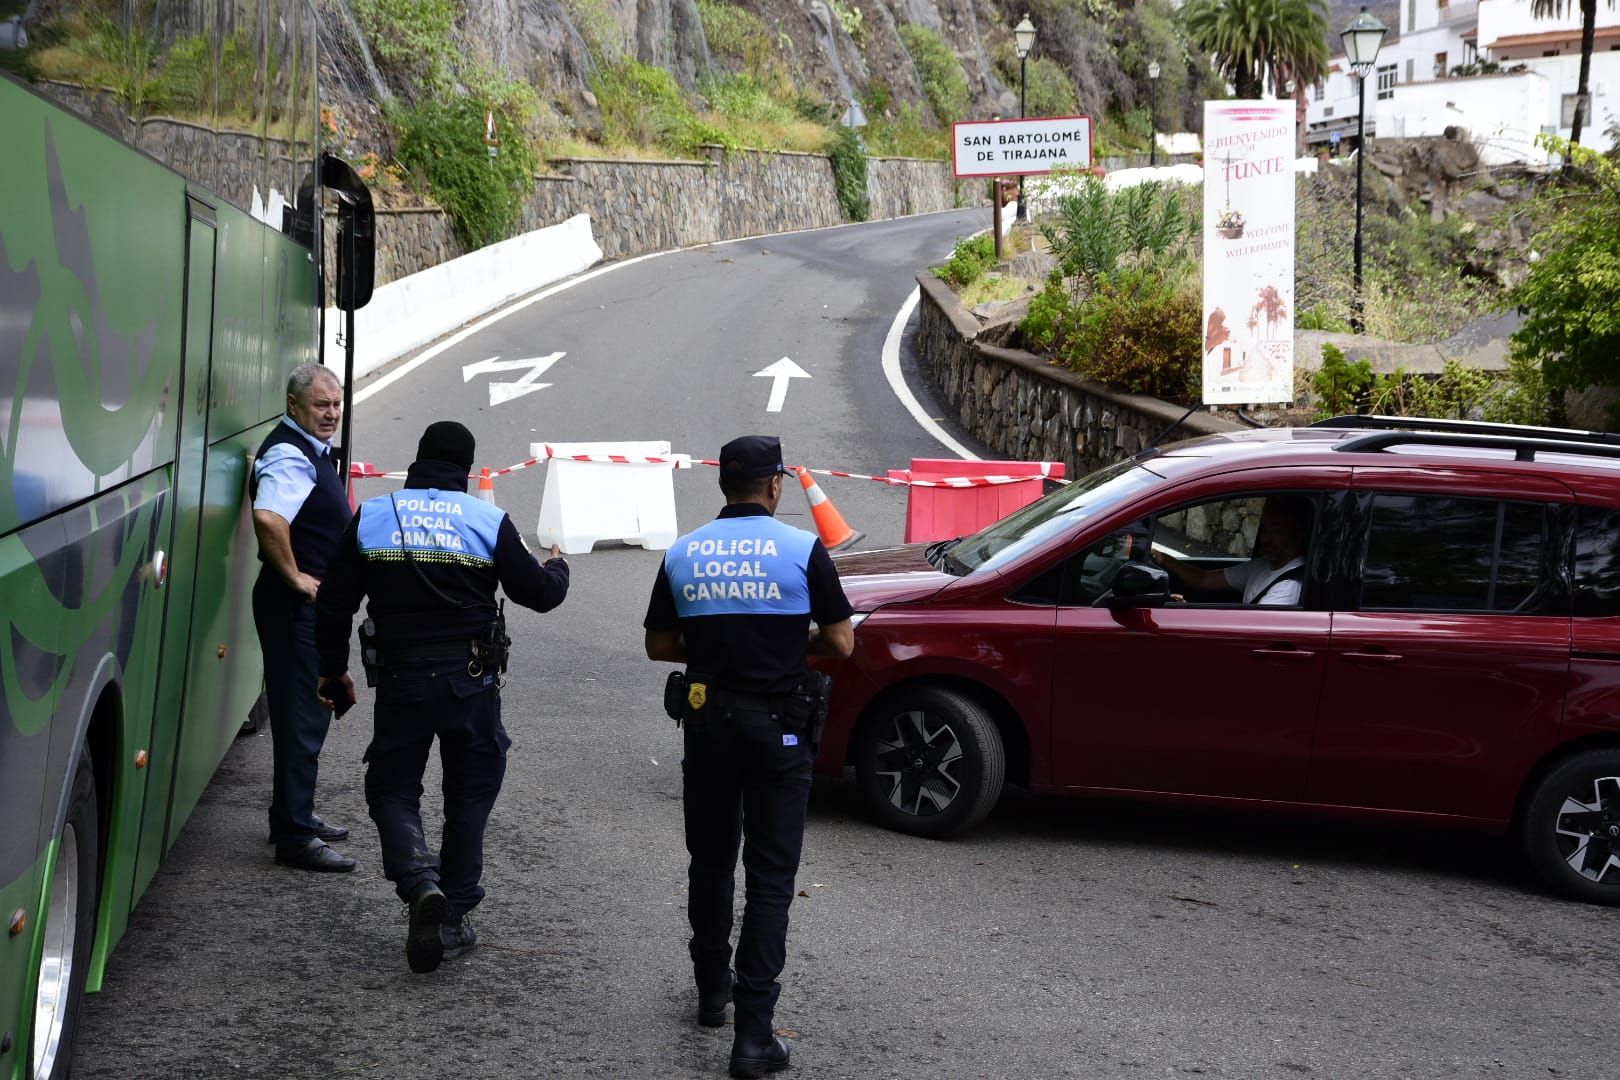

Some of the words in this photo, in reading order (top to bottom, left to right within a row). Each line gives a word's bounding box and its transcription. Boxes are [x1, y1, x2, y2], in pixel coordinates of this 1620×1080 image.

[963, 136, 992, 146] SAN
[999, 129, 1081, 145] BARTOLOMÉ
[1216, 126, 1288, 148] BIENVENIDO
[977, 151, 994, 161] DE
[1002, 148, 1067, 160] TIRAJANA
[1222, 156, 1284, 182] TUNTE
[1247, 223, 1289, 239] WELCOME
[1226, 240, 1289, 257] WILLKOMMEN
[397, 500, 463, 515] POLICIA
[402, 515, 455, 531] LOCAL
[391, 530, 463, 550] CANARIA
[687, 538, 778, 557] POLICIA
[693, 560, 767, 578] LOCAL
[683, 581, 782, 602] CANARIA
